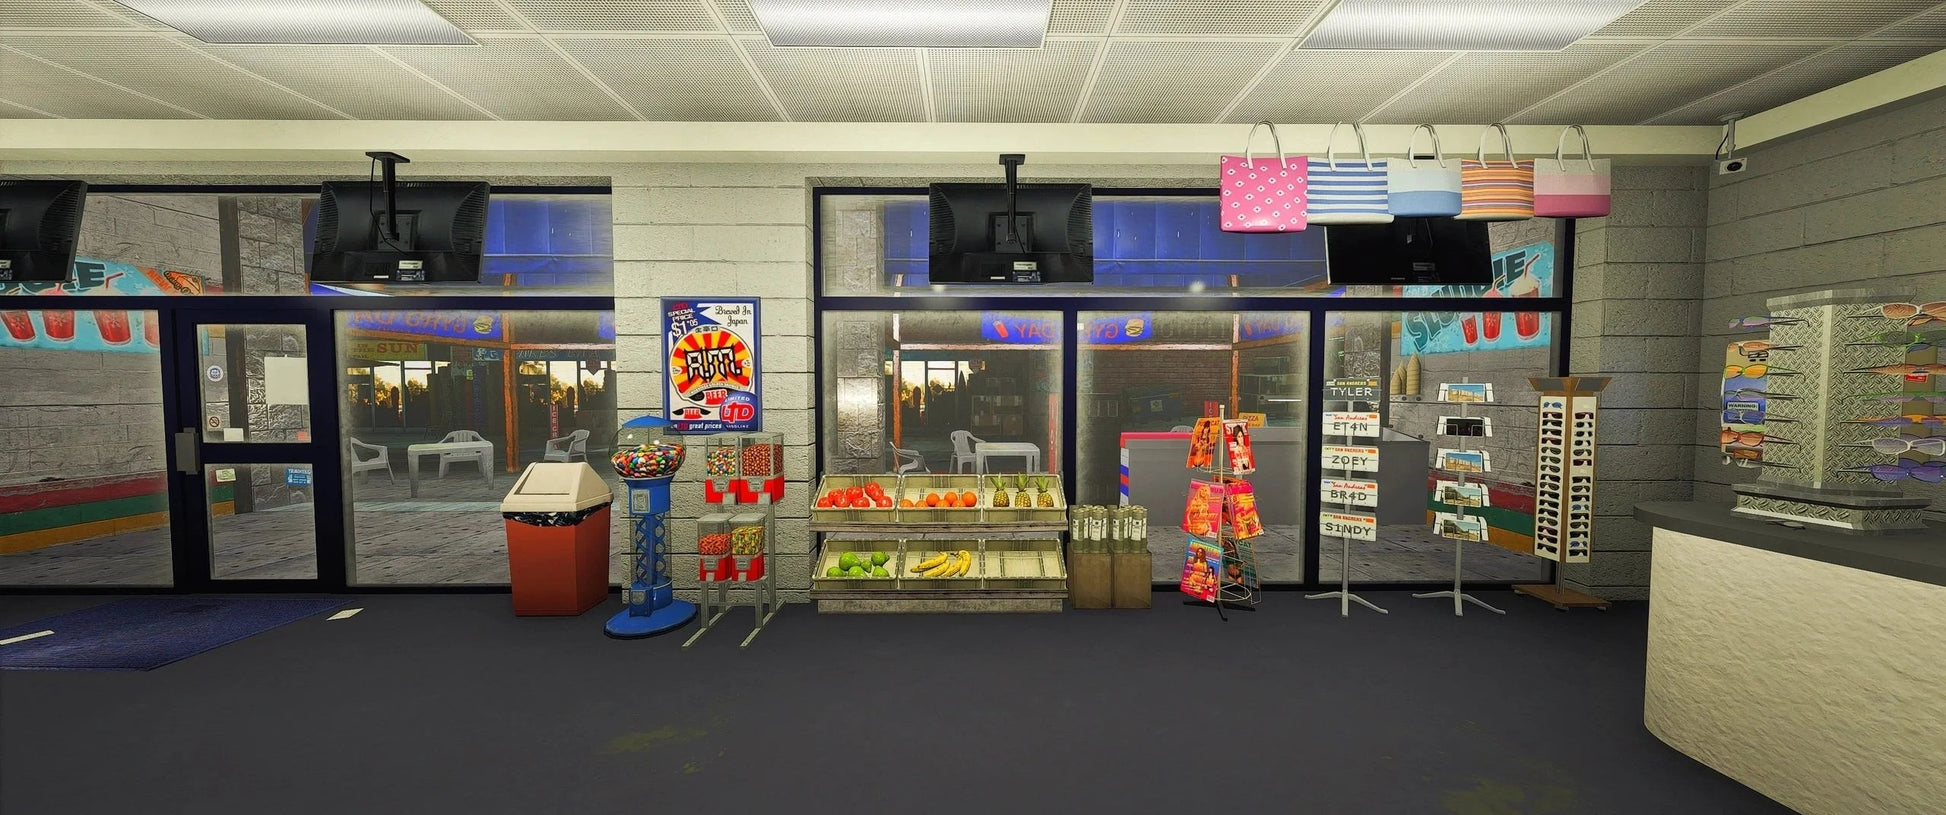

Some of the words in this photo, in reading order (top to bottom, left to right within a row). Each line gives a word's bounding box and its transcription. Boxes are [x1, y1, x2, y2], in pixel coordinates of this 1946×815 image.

[668, 308, 696, 317] SPECIAL
[715, 305, 741, 316] Brewed
[742, 305, 752, 316] In
[727, 315, 748, 327] Japan
[376, 342, 419, 355] SUN
[705, 389, 726, 400] BEER
[1330, 387, 1373, 397] TYLER
[689, 421, 703, 431] great
[704, 420, 722, 431] prices
[1333, 422, 1368, 432] ET4N
[1332, 455, 1368, 466] ZOEY
[1330, 490, 1367, 501] BR4D
[1325, 522, 1371, 536] S1NDY
